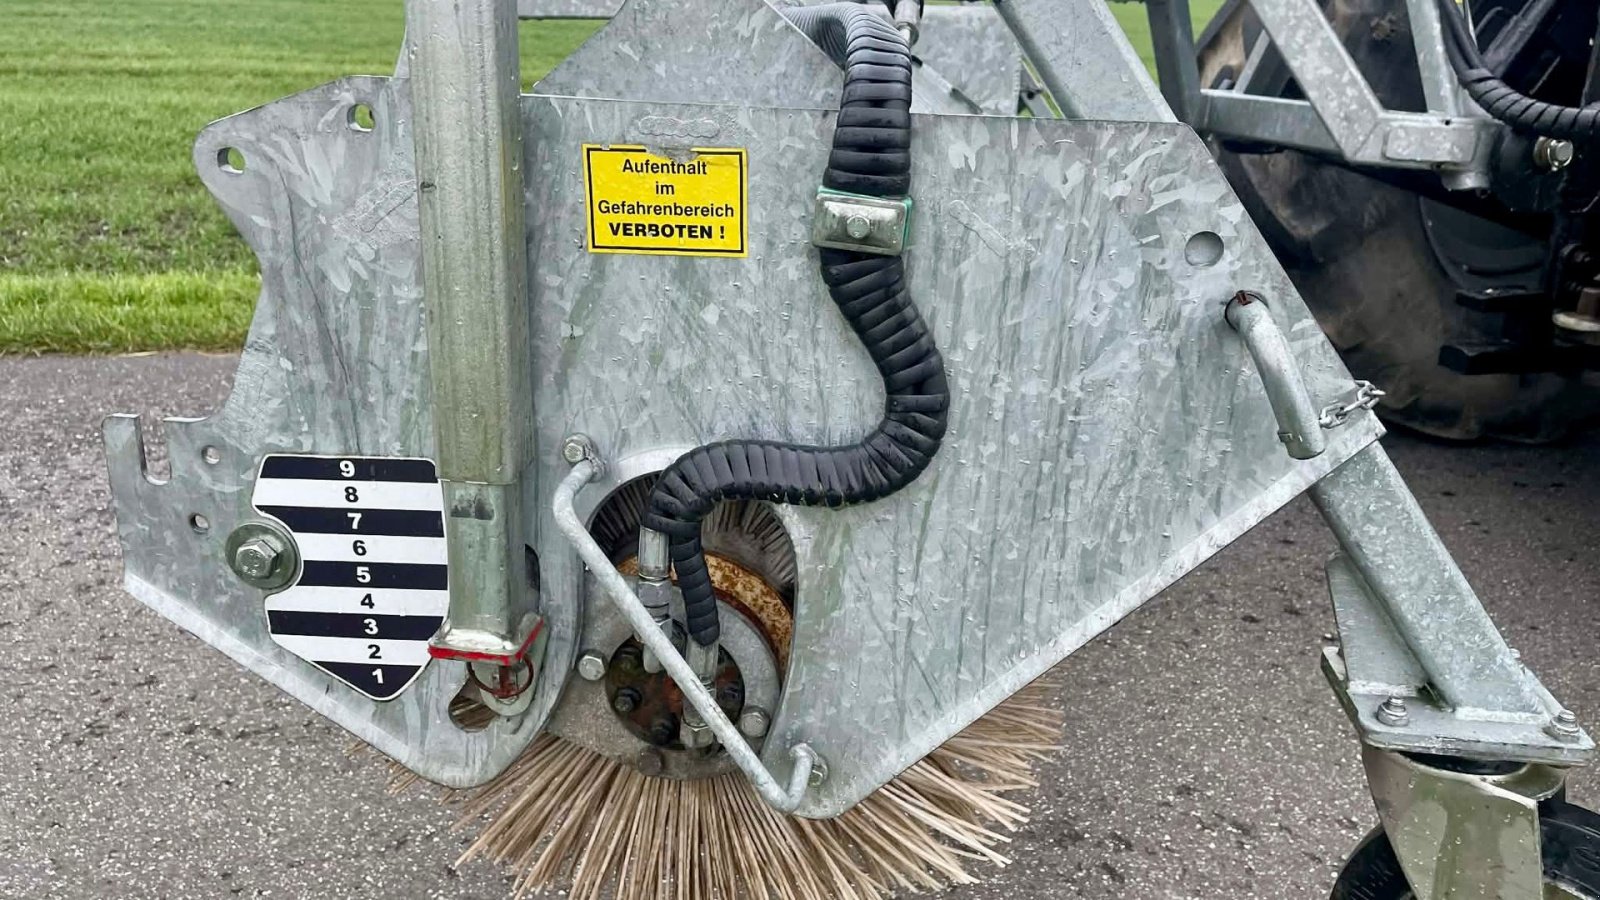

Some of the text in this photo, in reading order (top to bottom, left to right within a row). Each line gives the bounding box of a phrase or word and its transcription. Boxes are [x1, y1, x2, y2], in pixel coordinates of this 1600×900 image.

[655, 181, 675, 195] im
[598, 200, 734, 217] Gefahrenbereich
[609, 223, 725, 239] VERBOTEN !
[339, 460, 356, 478] 9
[344, 486, 359, 503] 8
[347, 512, 362, 530] 7
[352, 540, 367, 556] 6
[356, 566, 371, 583] 5
[360, 593, 375, 609] 4
[363, 618, 379, 635] 3
[367, 644, 382, 659] 2
[371, 668, 384, 684] 1
